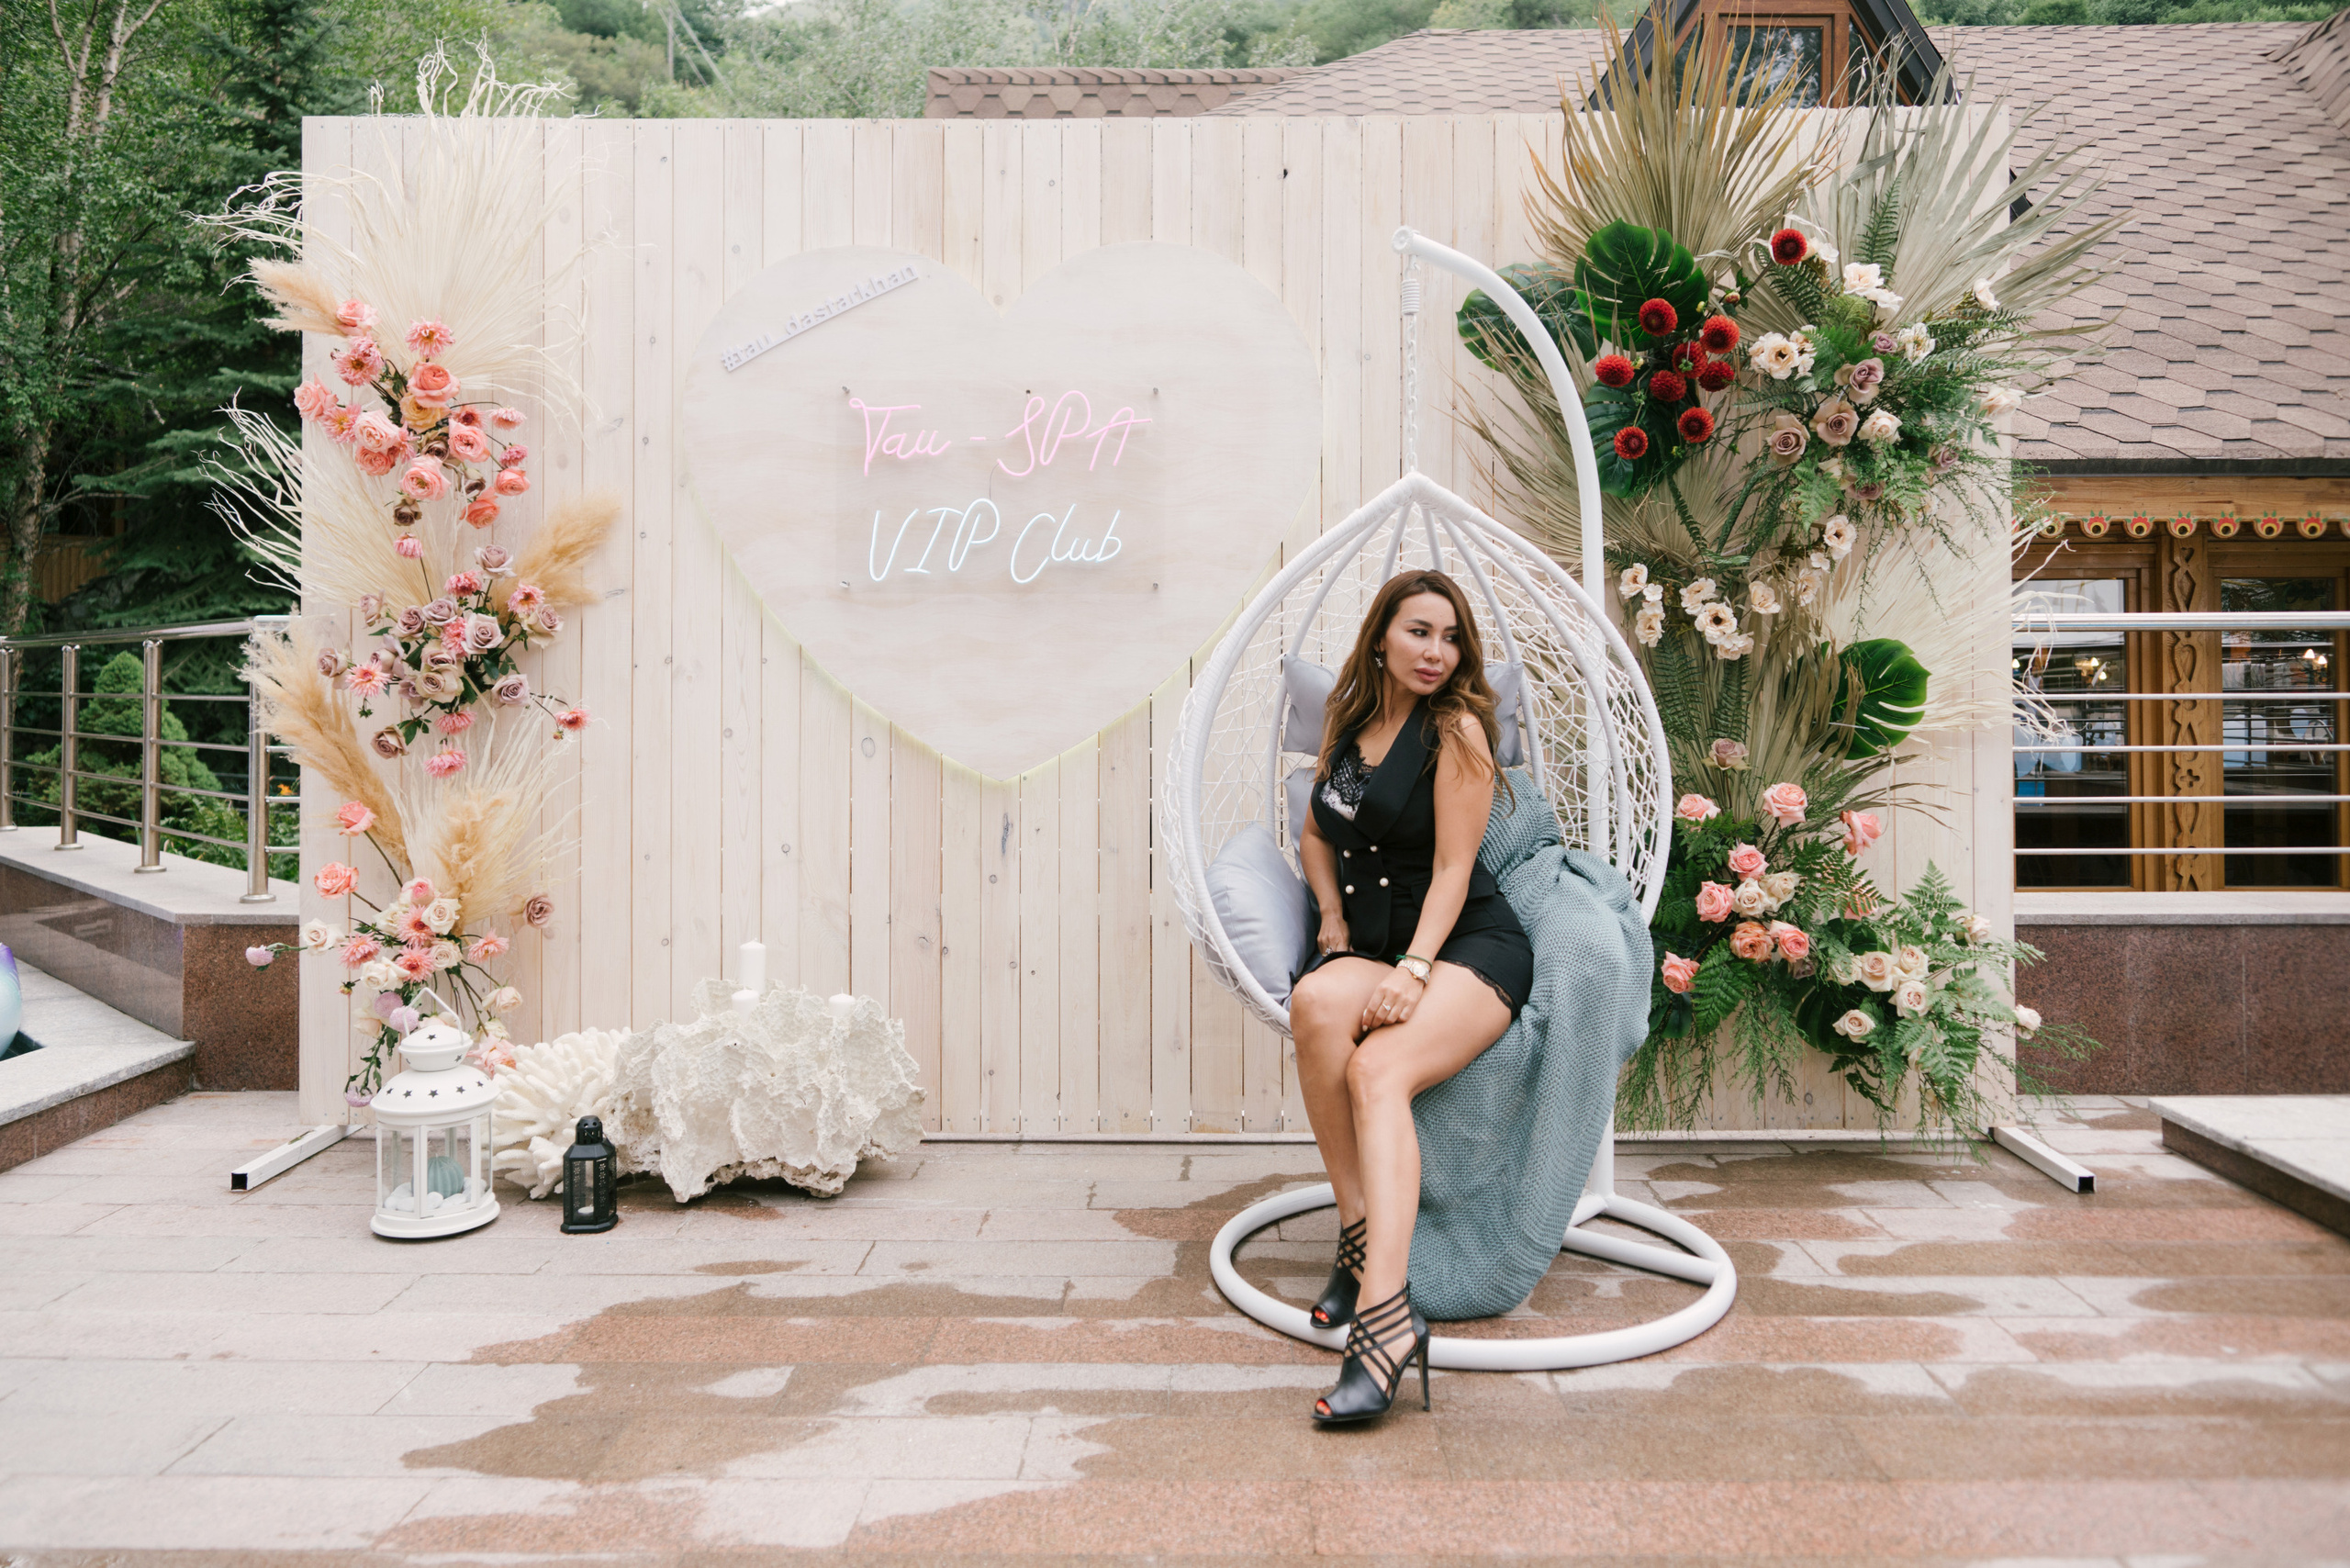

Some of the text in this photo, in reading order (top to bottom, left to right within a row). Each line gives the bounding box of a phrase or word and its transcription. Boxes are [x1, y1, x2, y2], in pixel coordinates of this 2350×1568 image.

[721, 263, 918, 372] #tau_dastarkhan
[849, 398, 952, 476] Tau
[997, 390, 1152, 476] SPA
[869, 498, 1122, 584] VIP Club
